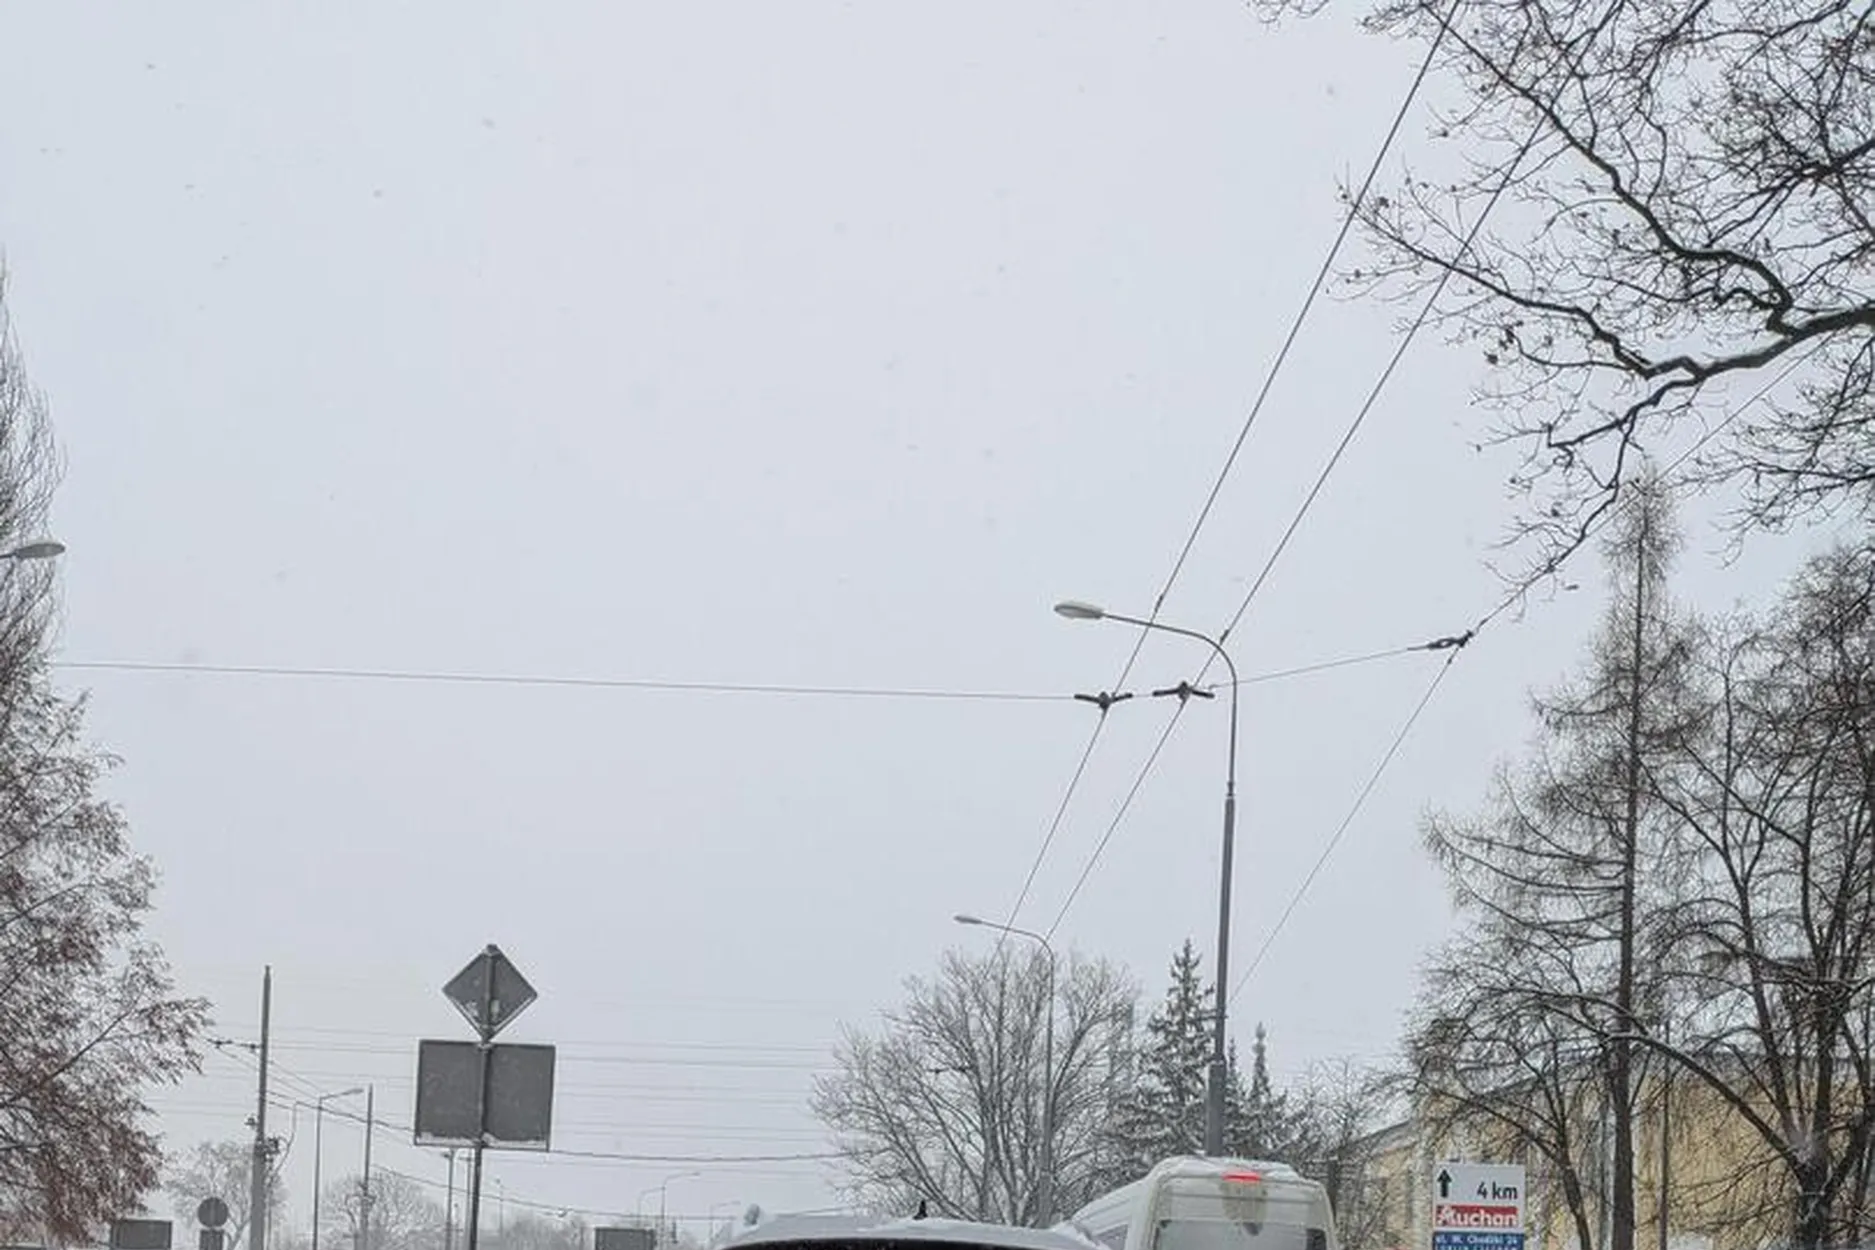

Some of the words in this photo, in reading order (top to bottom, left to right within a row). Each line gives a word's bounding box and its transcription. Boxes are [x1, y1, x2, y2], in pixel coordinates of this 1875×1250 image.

[1477, 1181, 1488, 1199] 4
[1492, 1181, 1518, 1200] km
[1437, 1206, 1518, 1226] Auchan
